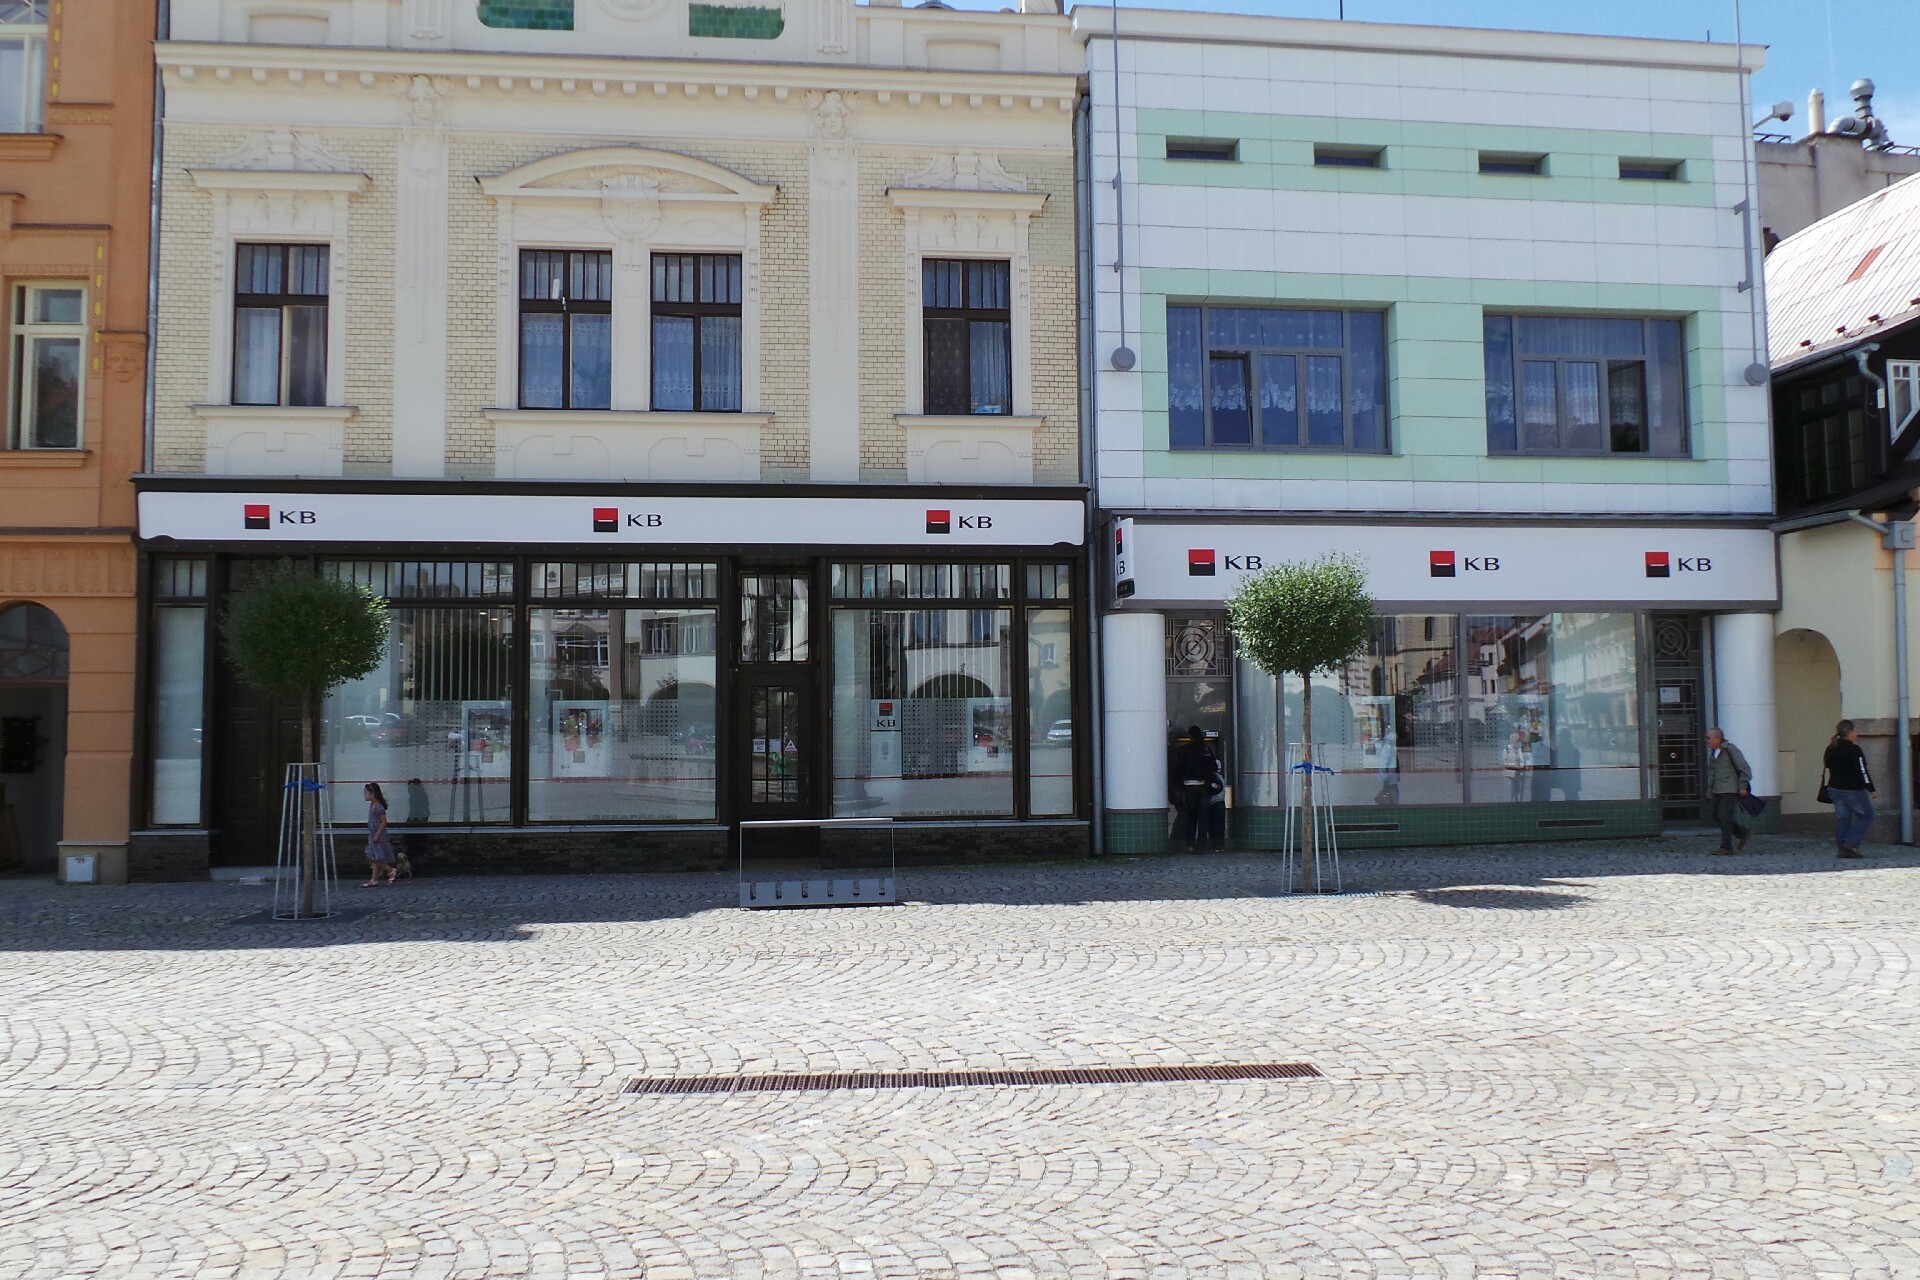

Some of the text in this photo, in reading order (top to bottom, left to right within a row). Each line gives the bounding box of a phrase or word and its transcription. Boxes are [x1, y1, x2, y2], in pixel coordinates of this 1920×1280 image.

[279, 510, 317, 524] KB
[627, 514, 663, 528] KB
[957, 516, 993, 529] KB
[1224, 555, 1263, 570] KB
[1464, 557, 1500, 571] KB
[1677, 557, 1712, 572] KB
[876, 719, 896, 728] KB
